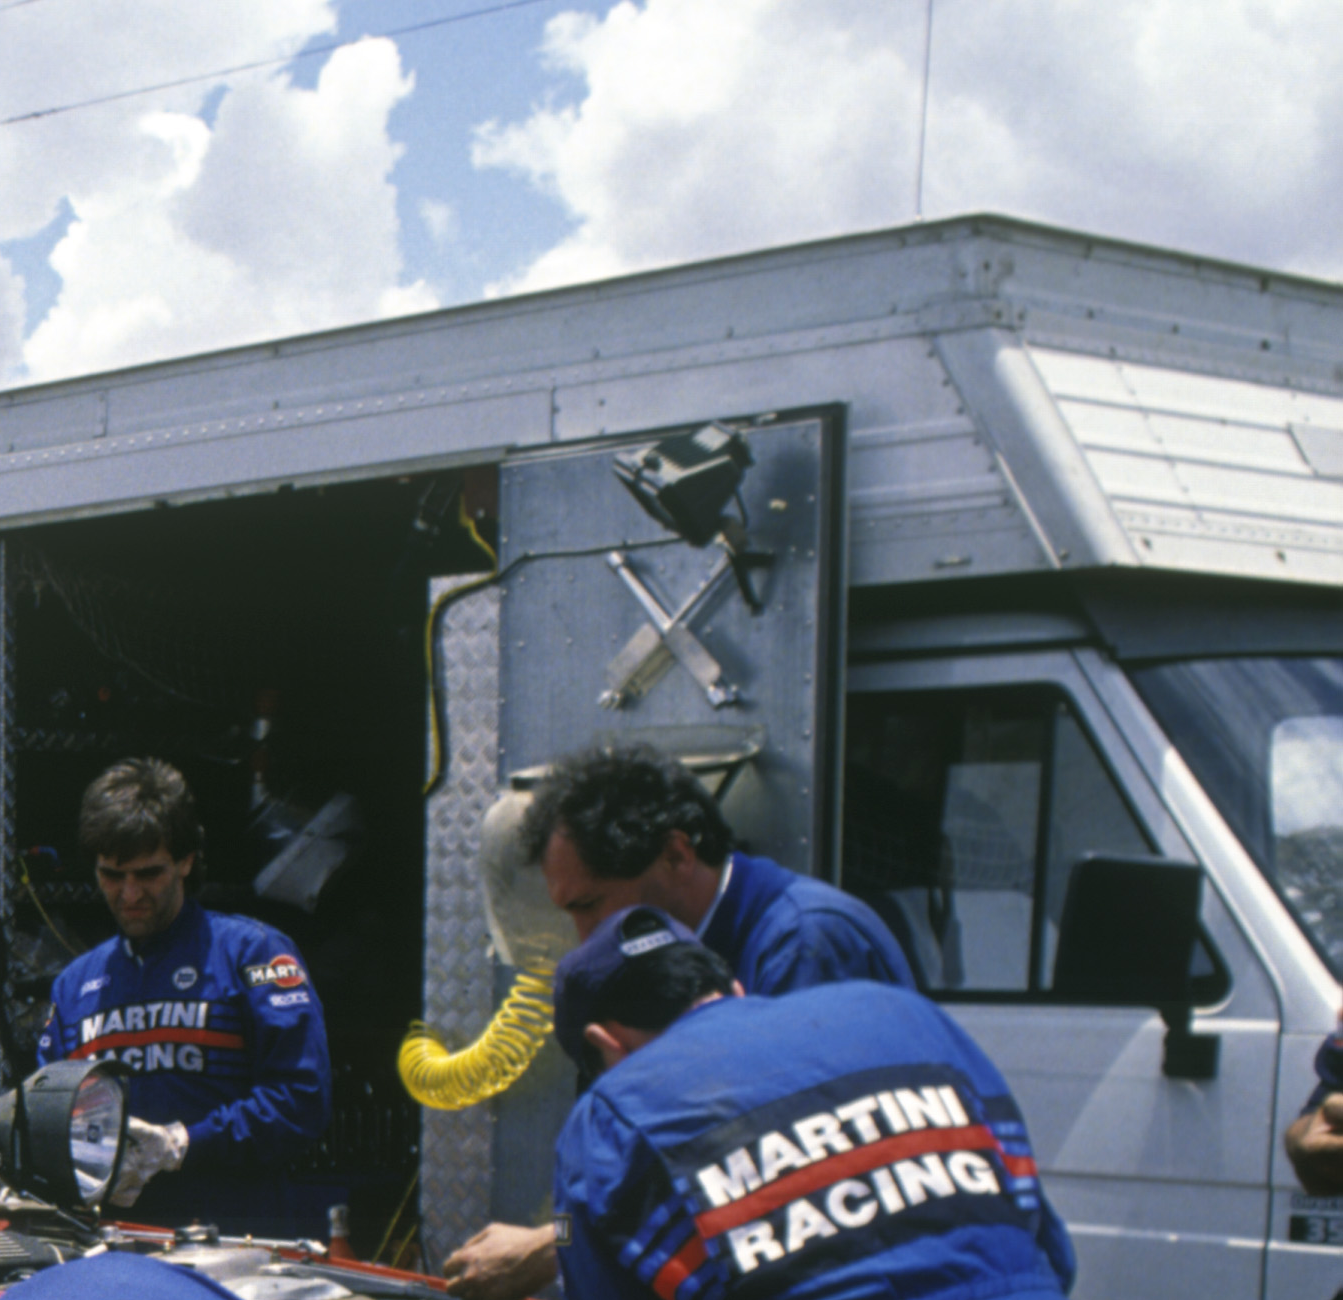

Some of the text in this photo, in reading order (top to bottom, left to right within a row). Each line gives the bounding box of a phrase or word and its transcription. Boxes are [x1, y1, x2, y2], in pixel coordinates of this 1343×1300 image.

[81, 1001, 209, 1044] MARTINI
[87, 1042, 204, 1072] CING
[696, 1085, 973, 1209] MARTINI
[725, 1149, 1001, 1275] RACING
